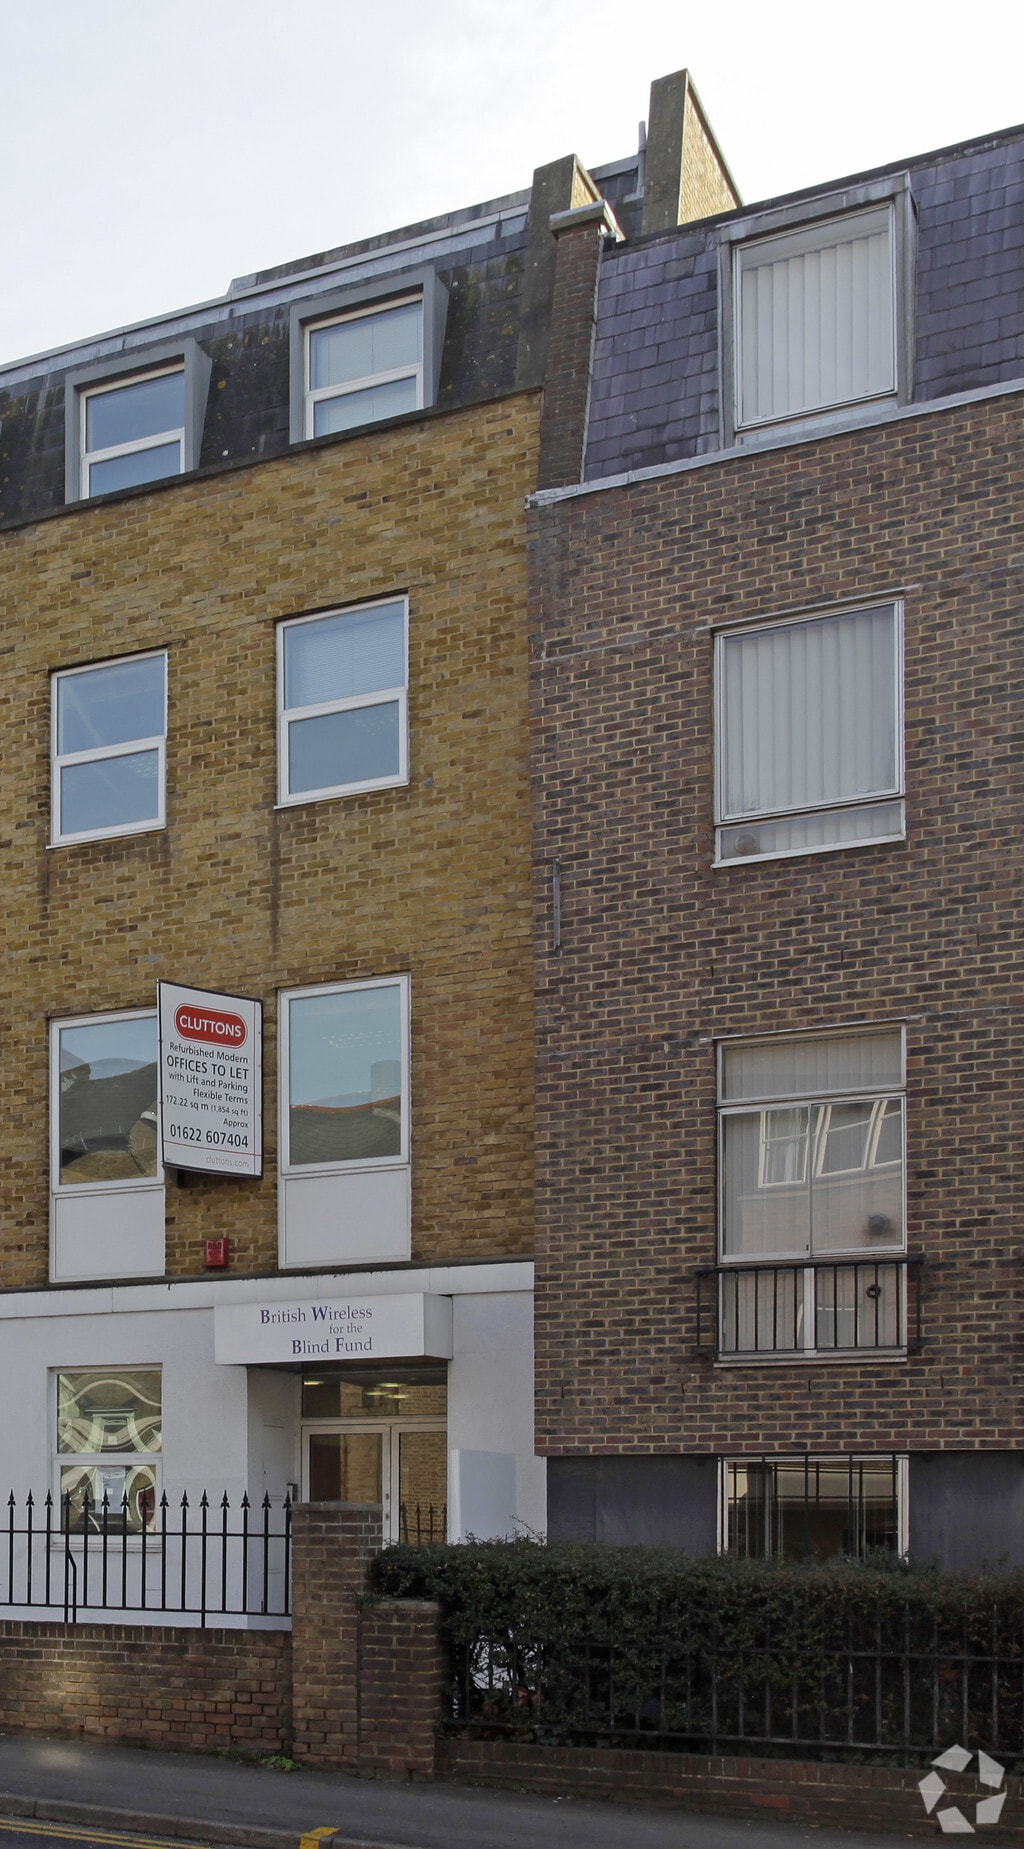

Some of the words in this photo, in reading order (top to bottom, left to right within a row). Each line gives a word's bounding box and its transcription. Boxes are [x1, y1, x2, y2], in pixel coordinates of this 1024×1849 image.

[179, 1015, 242, 1038] CLUTTONS
[169, 1042, 214, 1059] Refurbished
[217, 1050, 249, 1064] Modern
[167, 1055, 207, 1073] OFFICES
[212, 1064, 226, 1076] TO
[230, 1067, 249, 1079] LET
[169, 1072, 184, 1081] with
[186, 1074, 199, 1085] Lift
[201, 1077, 216, 1087] and
[219, 1080, 248, 1094] Parking
[166, 1095, 187, 1108] 172.22
[190, 1101, 199, 1111] sq
[201, 1103, 208, 1111] m
[193, 1089, 222, 1100] Flexible
[225, 1094, 248, 1104] Terms
[223, 1118, 248, 1129] Approx
[170, 1124, 202, 1142] 01622
[206, 1130, 249, 1148] 607404
[206, 1154, 249, 1168] cluttons.com
[260, 1308, 306, 1325] British
[311, 1305, 373, 1322] Wireless
[329, 1324, 344, 1334] for
[347, 1323, 363, 1333] the
[291, 1339, 329, 1355] Blind
[335, 1337, 372, 1353] Fund
